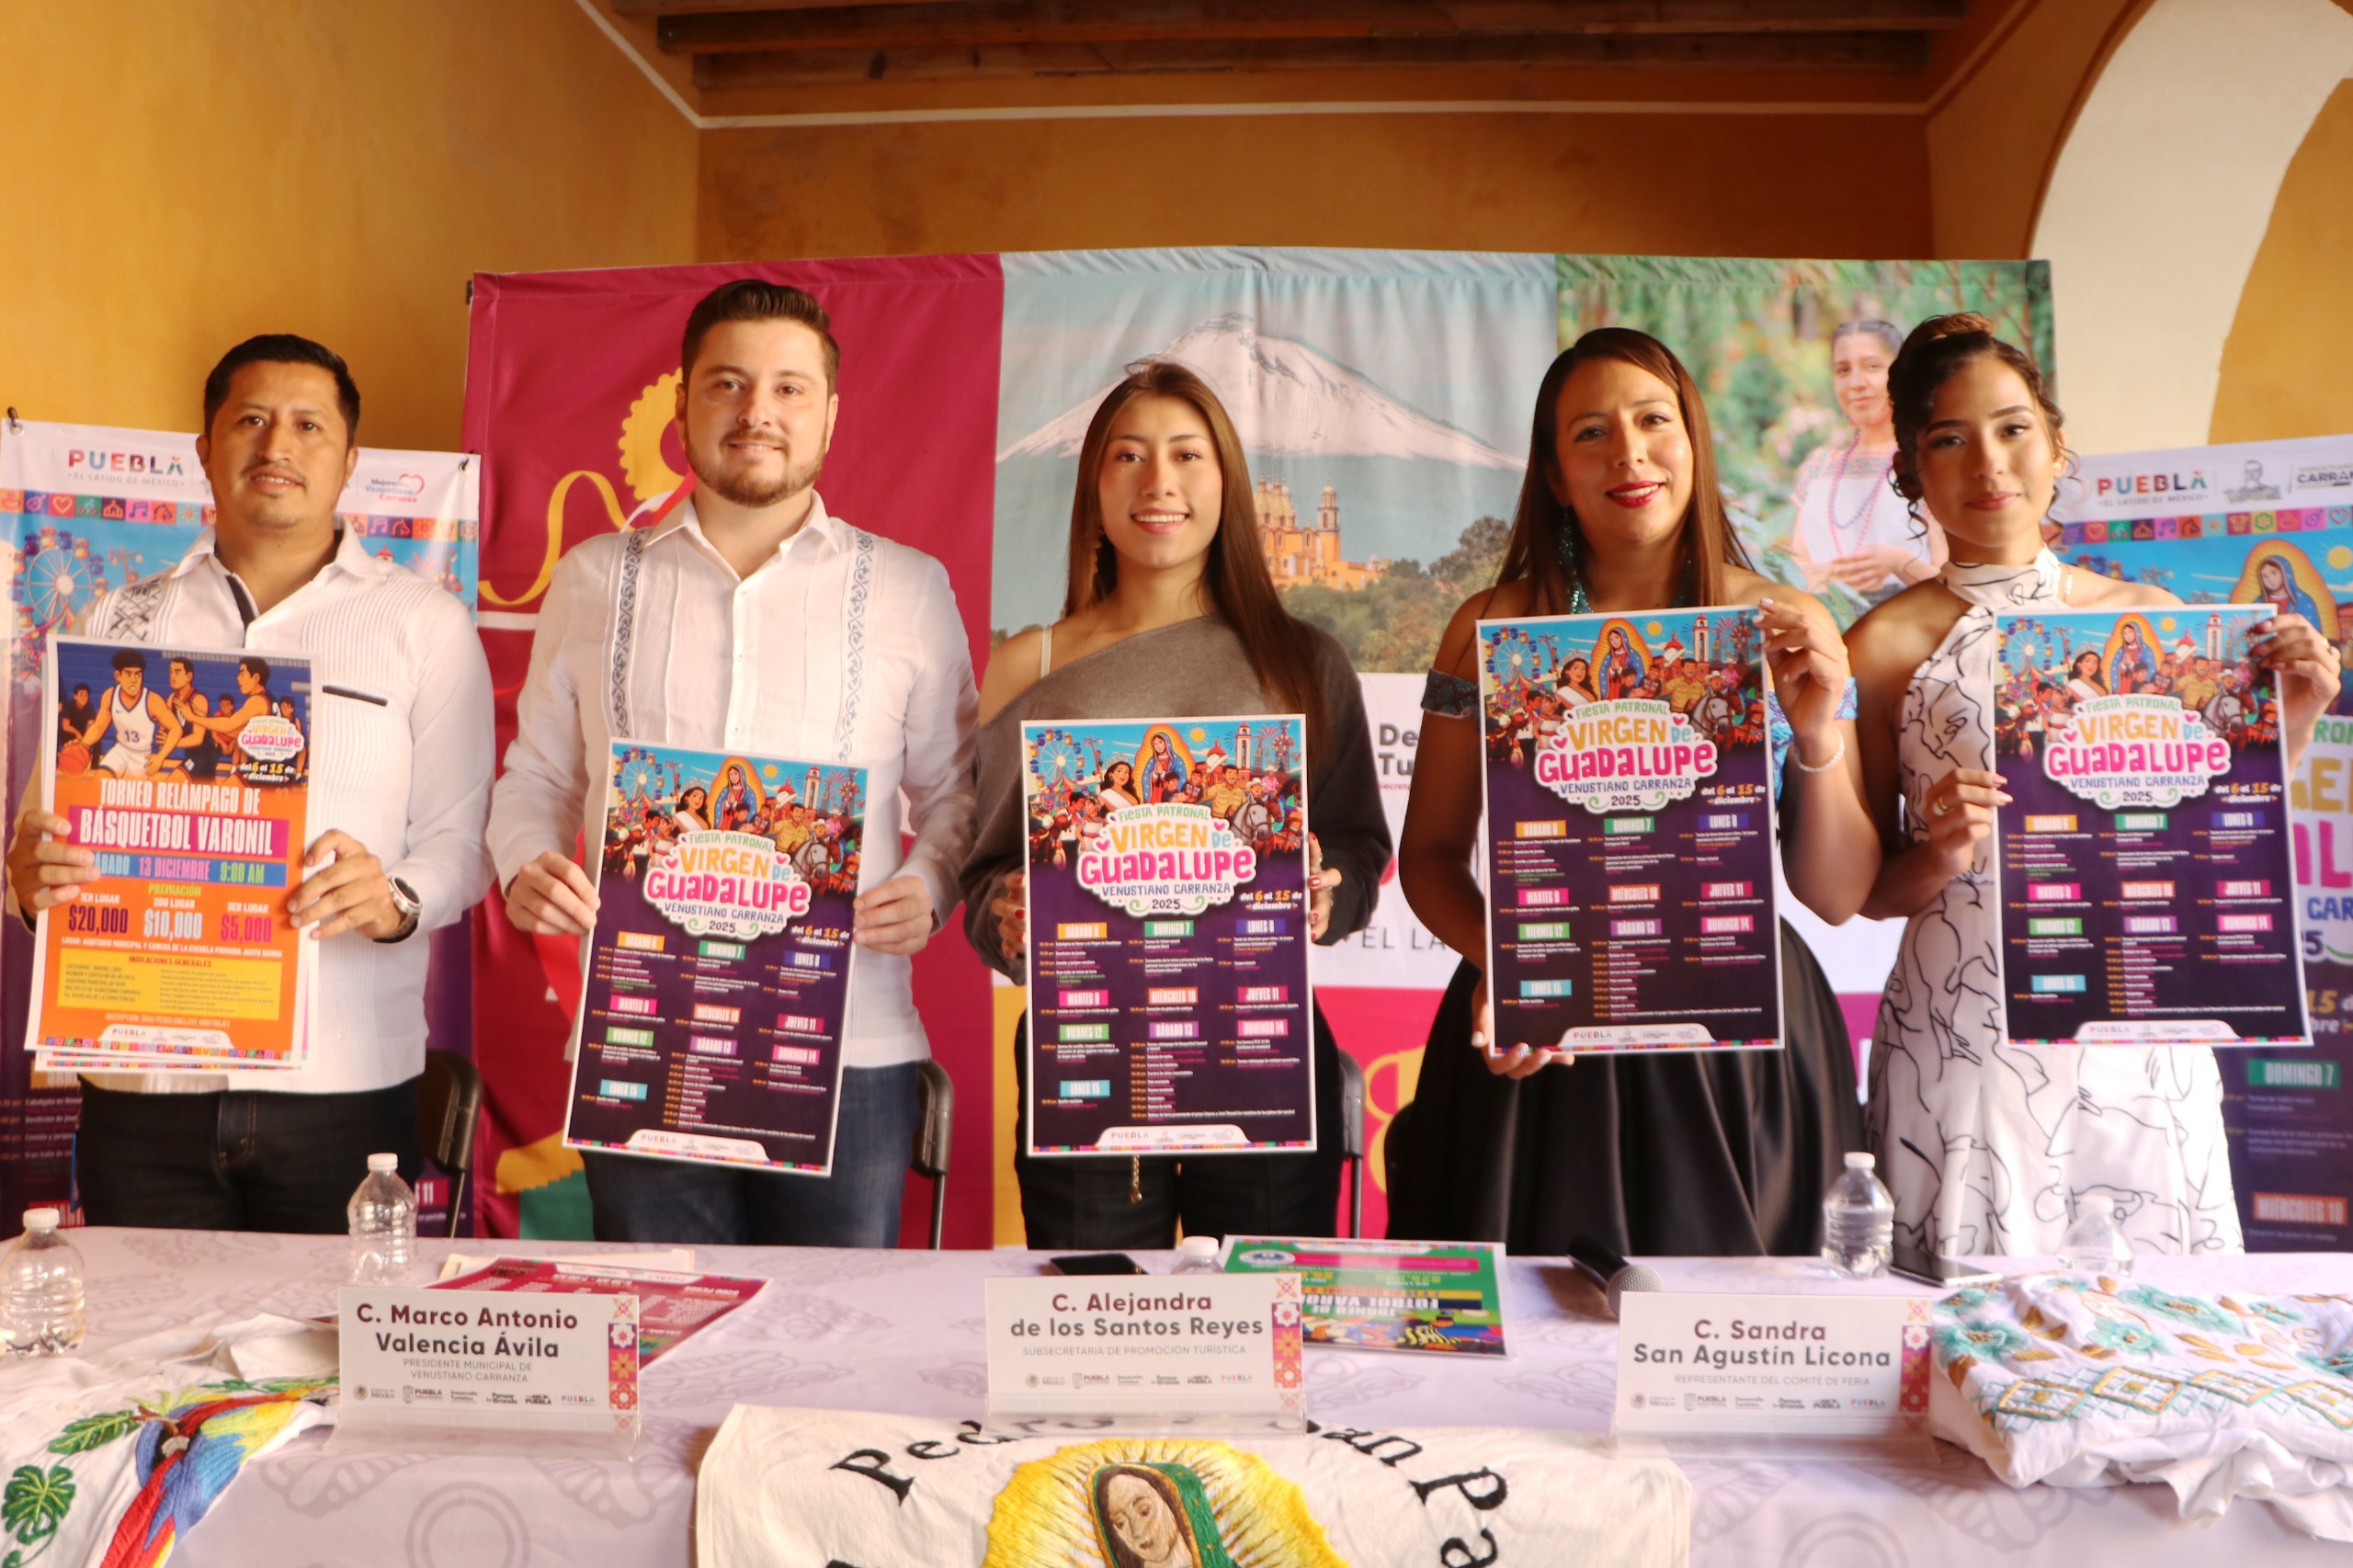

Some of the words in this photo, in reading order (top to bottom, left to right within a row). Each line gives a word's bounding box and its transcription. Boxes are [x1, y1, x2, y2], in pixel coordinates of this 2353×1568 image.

[69, 449, 184, 476] PUEBLA
[88, 474, 122, 483] LATIDO
[142, 477, 178, 486] MÉXICO
[2097, 472, 2208, 495] PUEBLA
[1614, 701, 1668, 715] PATRONAL
[2126, 697, 2180, 711] PATRONAL
[1566, 716, 1666, 750] VIRGEN
[2077, 712, 2178, 744] VIRGEN
[125, 731, 140, 743] 13
[1560, 781, 1629, 794] VENUSTIANO
[1633, 778, 1692, 791] CARRANZA
[2071, 778, 2141, 789] VENUSTIANO
[2145, 775, 2206, 787] CARRANZA
[100, 778, 153, 808] TORNEO
[156, 780, 239, 813] RELÁMPAGO
[244, 788, 261, 814] DE
[1611, 795, 1641, 806] 2025
[2122, 791, 2154, 802] 2025
[1157, 806, 1210, 821] PATRONAL
[80, 805, 190, 850] BÁSQUETBOL
[198, 816, 273, 856] VARONIL
[1109, 821, 1207, 853] VIRGEN
[725, 833, 775, 853] PATRONAL
[93, 852, 131, 876] ÁBADO
[139, 857, 150, 876] 13
[154, 858, 210, 881] DICIEMBRE
[220, 862, 245, 883] 9:00
[247, 864, 265, 884] AM
[679, 846, 770, 879] VIRGEN
[148, 882, 201, 897] PREMIACIÓN
[1102, 884, 1169, 896] VENUSTIANO
[1174, 882, 1231, 894] CARRANZA
[1240, 892, 1254, 901] del
[1255, 891, 1263, 901] 6
[1264, 892, 1273, 901] al
[1275, 891, 1290, 901] 15
[1292, 892, 1302, 900] de
[95, 892, 120, 903] LUGAR
[170, 898, 195, 909] LUGAR
[1152, 899, 1181, 910] 2025
[244, 903, 269, 914] LUGAR
[665, 902, 728, 918] VENUSTIANO
[732, 909, 784, 924] CARRANZA
[1252, 901, 1292, 910] diciembre
[69, 904, 129, 935] $20,000
[144, 909, 203, 941] $10,000
[709, 920, 736, 933] 2025
[1247, 920, 1267, 933] LUNES
[221, 914, 272, 944] $5,000
[1065, 923, 1092, 937] SÁBADO
[1154, 922, 1184, 937] DOMINGO
[1067, 991, 1094, 1006] MARTES
[1151, 988, 1187, 1004] MIÉRCOLES
[1246, 988, 1271, 1001] JUEVES
[1066, 1025, 1093, 1040] VIERNES
[1155, 1023, 1182, 1037] SÁBADO
[1243, 1020, 1274, 1036] DOMINGO
[2265, 1061, 2323, 1085] DOMINGO
[2326, 1063, 2334, 1085] 7
[1070, 1082, 1092, 1096] LUNES
[2257, 1195, 2325, 1222] MIÉRCOLES
[2328, 1201, 2344, 1222] 10
[1051, 1293, 1077, 1312] C.
[1086, 1292, 1212, 1315] Alejandra
[357, 1303, 381, 1323] C.
[391, 1304, 469, 1326] Marco
[477, 1307, 578, 1330] Antonio
[1010, 1318, 1040, 1336] de
[1050, 1317, 1085, 1336] los
[1094, 1317, 1181, 1336] Santos
[1190, 1316, 1263, 1339] Reyes
[1694, 1319, 1720, 1340] C.
[1731, 1319, 1826, 1341] Sandra
[375, 1333, 484, 1355] Valencia
[494, 1331, 559, 1358] Ávila
[1107, 1346, 1120, 1356] DE
[1123, 1344, 1190, 1356] PROMOCIÓN
[1194, 1344, 1246, 1355] TURÍSTICA
[1633, 1344, 1683, 1364] San
[1693, 1344, 1794, 1369] Agustín
[1805, 1346, 1891, 1367] Licona
[404, 1358, 460, 1369] PRESIDENTE
[464, 1360, 517, 1371] MUNICIPAL
[519, 1362, 532, 1371] DE
[411, 1369, 472, 1381] VENUSTIANO
[475, 1372, 529, 1382] CARRANZA
[1675, 1374, 1758, 1385] REPRESENTANTE
[1761, 1375, 1780, 1385] DEL
[1783, 1373, 1824, 1386] COMITÉ
[1826, 1376, 1839, 1386] DE
[1842, 1376, 1870, 1386] FERIA
[1698, 1395, 1726, 1403] PUEBLA
